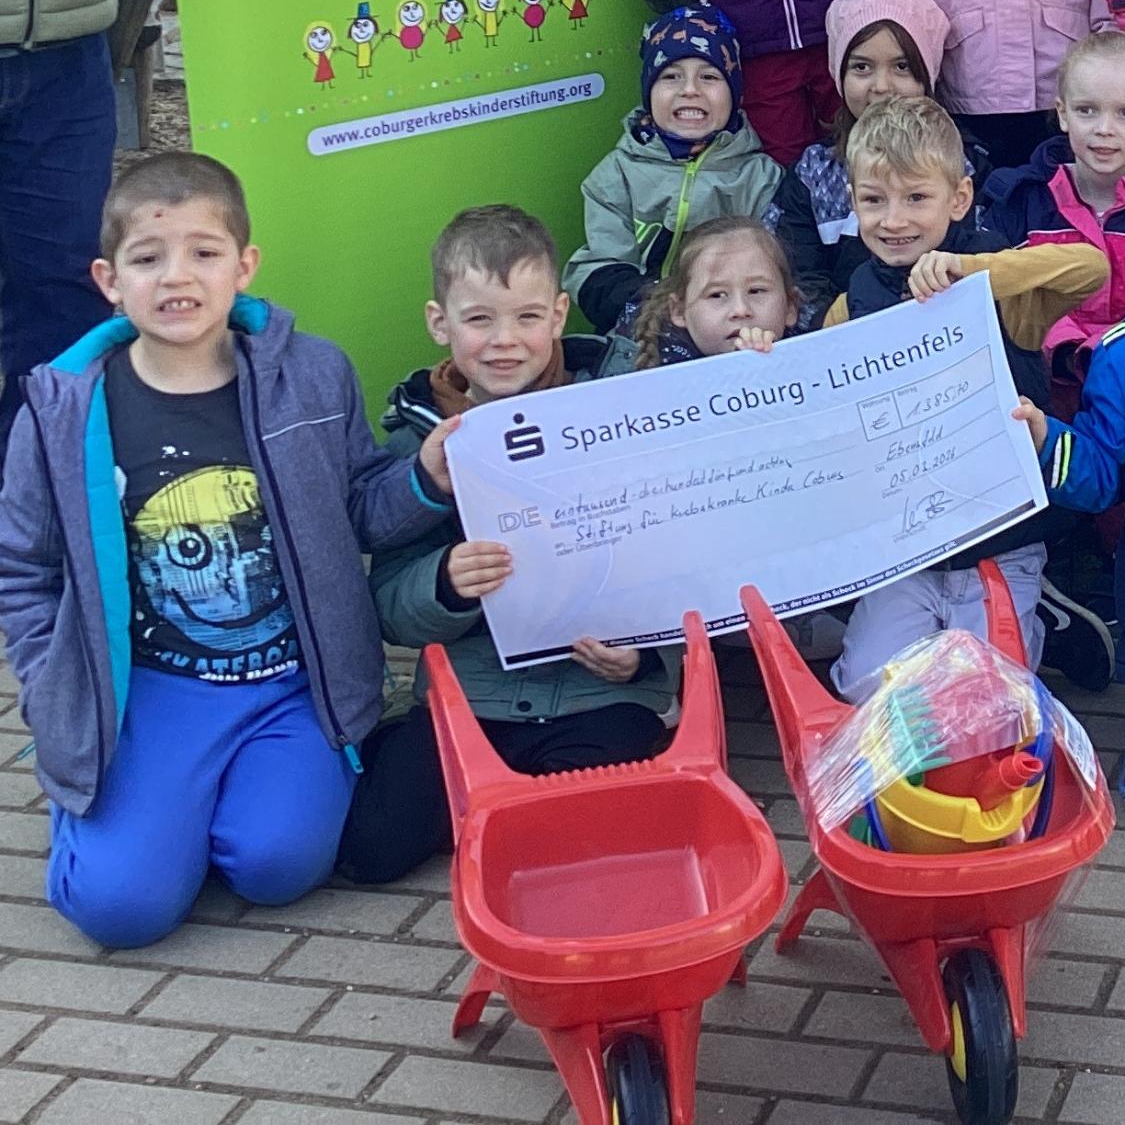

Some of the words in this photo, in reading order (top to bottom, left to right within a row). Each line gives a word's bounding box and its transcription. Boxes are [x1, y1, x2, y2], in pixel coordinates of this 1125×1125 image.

[322, 81, 593, 147] www.coburgerkrebskinderstiftung.org
[561, 404, 702, 452] Sparkasse
[709, 378, 805, 418] Coburg
[828, 325, 965, 390] Lichtenfels
[498, 506, 542, 533] DE
